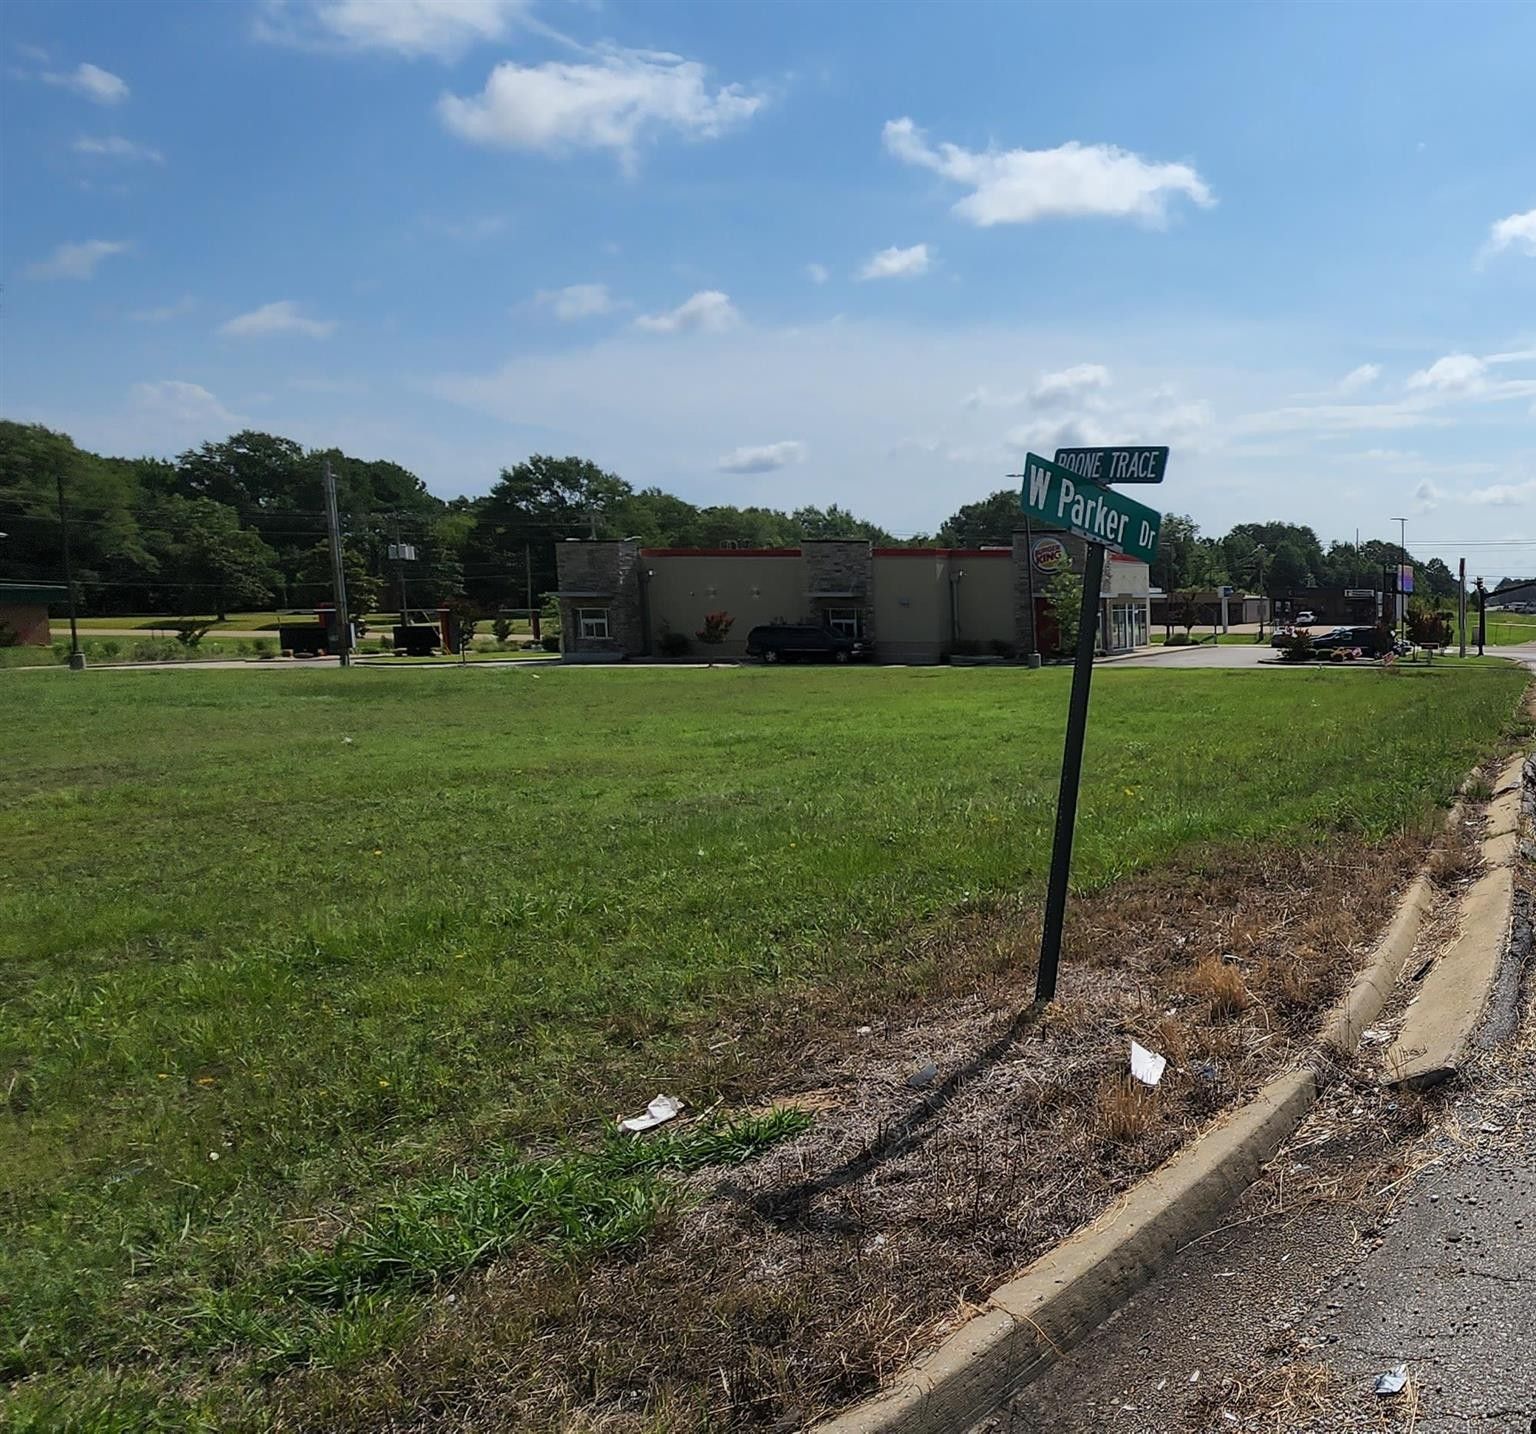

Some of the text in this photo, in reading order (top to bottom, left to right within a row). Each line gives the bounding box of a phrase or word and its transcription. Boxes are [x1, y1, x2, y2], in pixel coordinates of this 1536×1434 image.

[1058, 451, 1159, 478] BOONE TRACE
[1029, 464, 1156, 550] W Parker Dr
